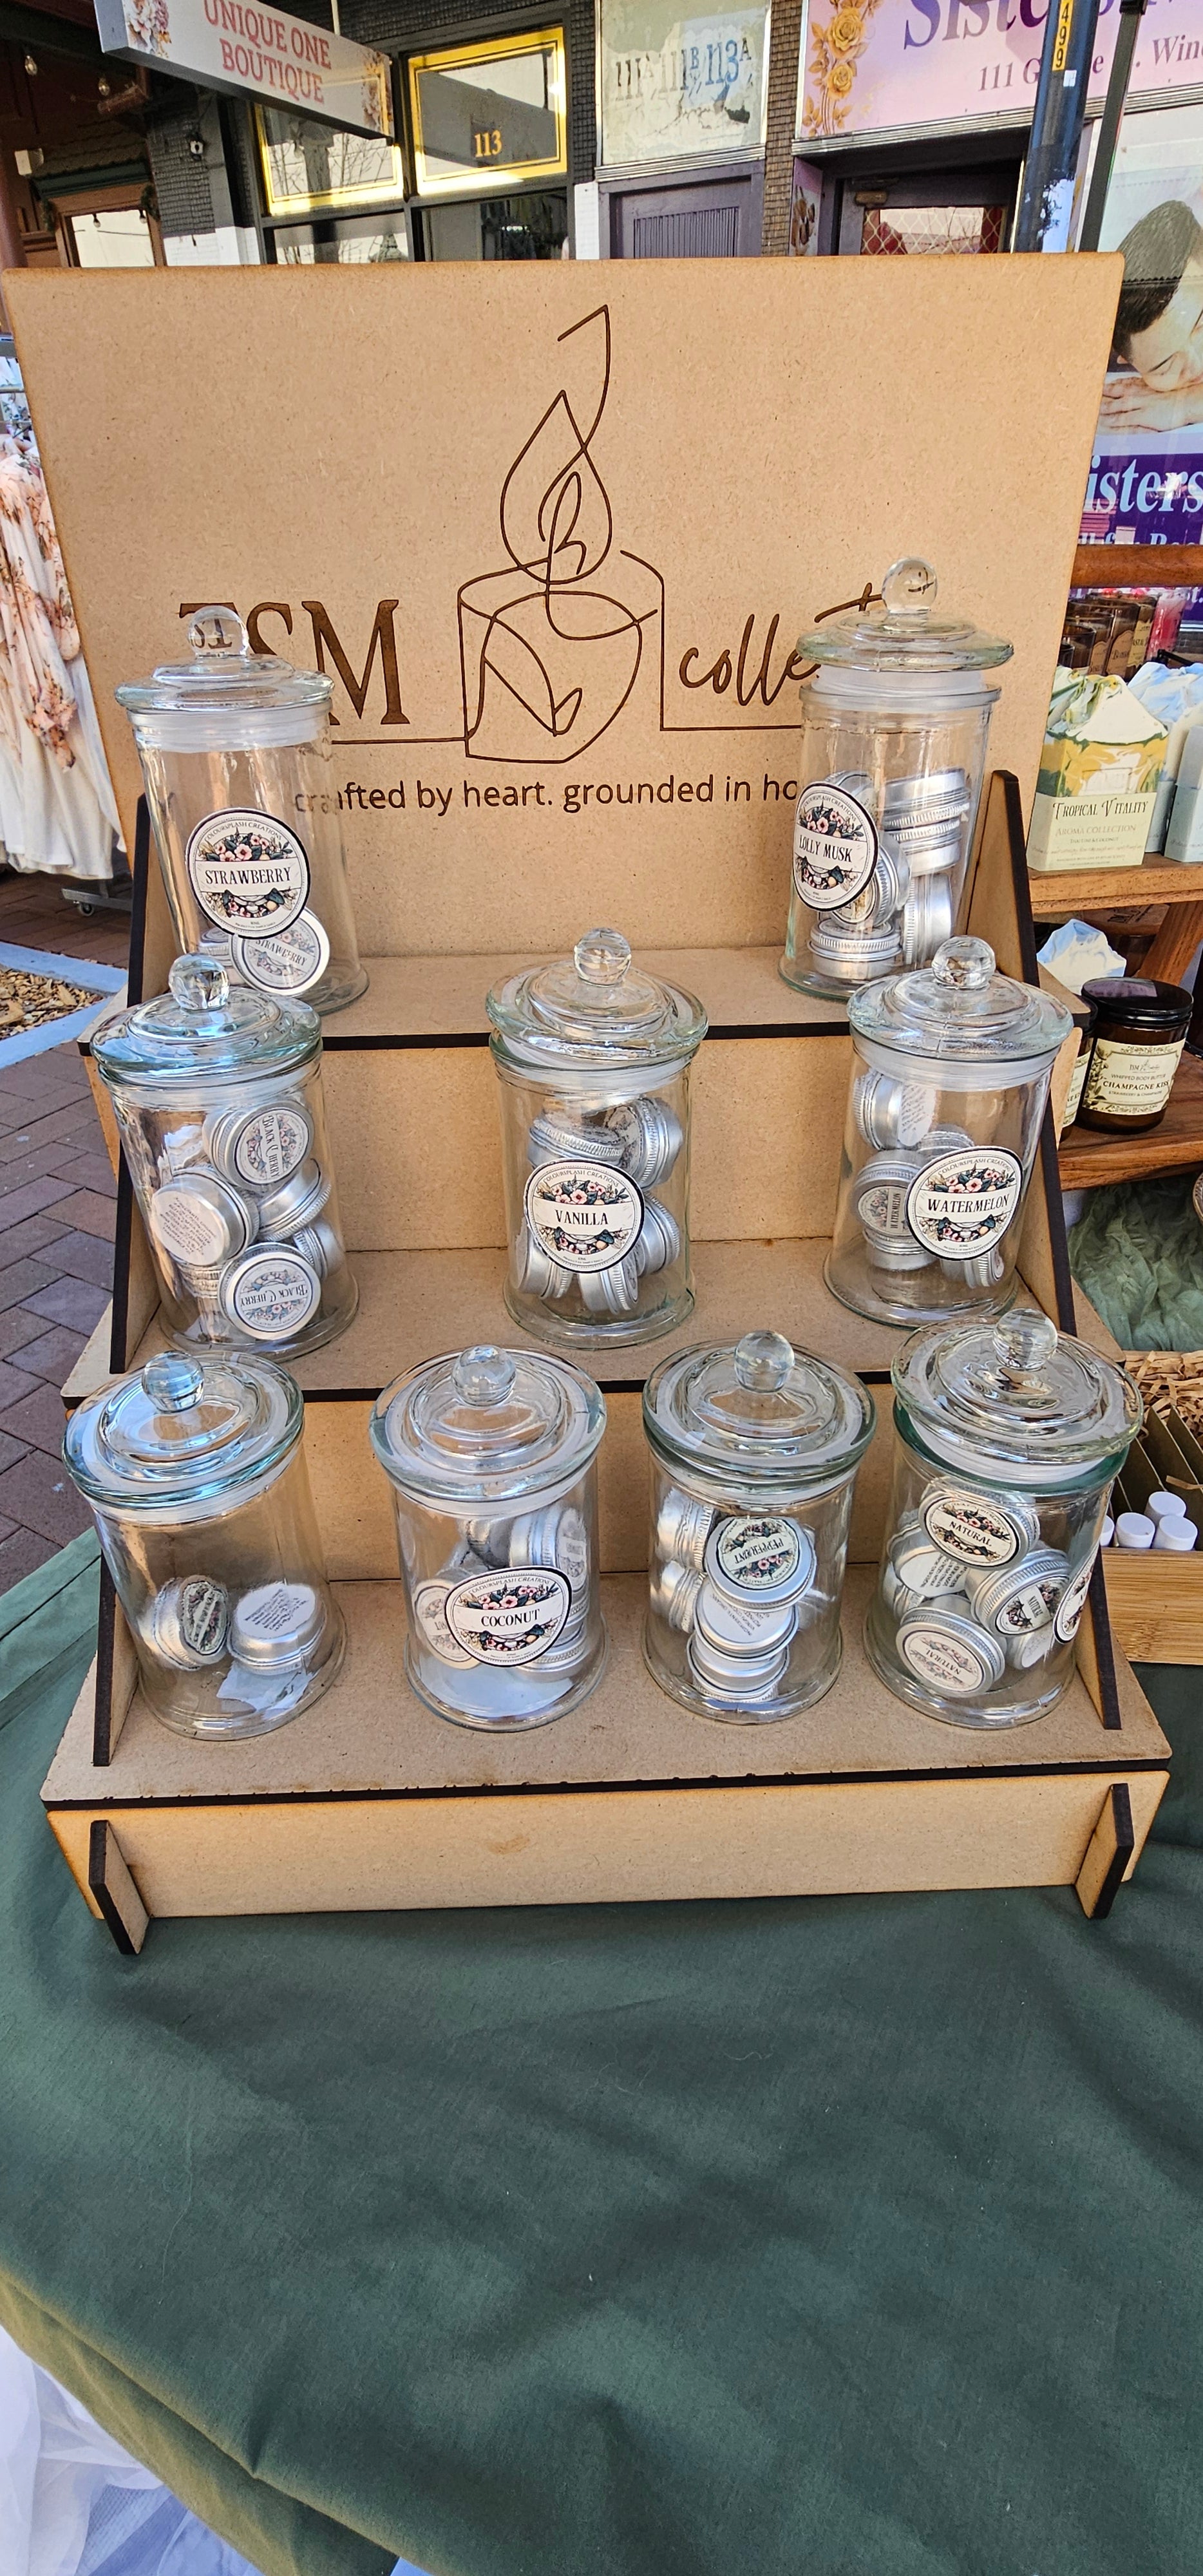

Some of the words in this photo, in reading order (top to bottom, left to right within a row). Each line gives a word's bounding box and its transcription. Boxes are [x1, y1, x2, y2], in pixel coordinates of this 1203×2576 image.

[203, 0, 287, 53] UNIQUE
[291, 27, 331, 70] ONE
[220, 38, 324, 104] BOUTIQUE
[978, 62, 1014, 91] 111
[475, 131, 503, 158] 113
[417, 781, 452, 817] by
[463, 780, 552, 809] heart.
[563, 774, 714, 814] grounded
[726, 775, 751, 802] in
[831, 797, 857, 822] CREATIONS
[1052, 802, 1098, 820] TROPICAL
[1101, 798, 1148, 817] VITALITY
[248, 822, 282, 840] CREATIONS
[1056, 826, 1085, 837] AROMA
[1086, 824, 1137, 836] COLLECTION
[799, 835, 820, 856] LOLLY
[823, 844, 853, 863] MUSK
[205, 867, 291, 885] STRAWBERRY
[1103, 1081, 1155, 1090] CHAMPAGNE
[261, 1115, 276, 1144] BLACK
[265, 1144, 280, 1179] CHERRY
[543, 1170, 585, 1183] COLOURSPLASH
[587, 1170, 619, 1188] CREATIONS
[927, 1193, 1010, 1213] WATERMELON
[555, 1209, 609, 1226] VANILLA
[240, 1289, 277, 1307] CHERRY
[278, 1283, 308, 1299] BLACK
[949, 1520, 992, 1547] NATURAL
[468, 1577, 516, 1595] COLOURSPLASH
[517, 1577, 550, 1585] CREATIONS
[481, 1609, 540, 1627] COCONUT
[925, 1648, 961, 1675] NATURAL
